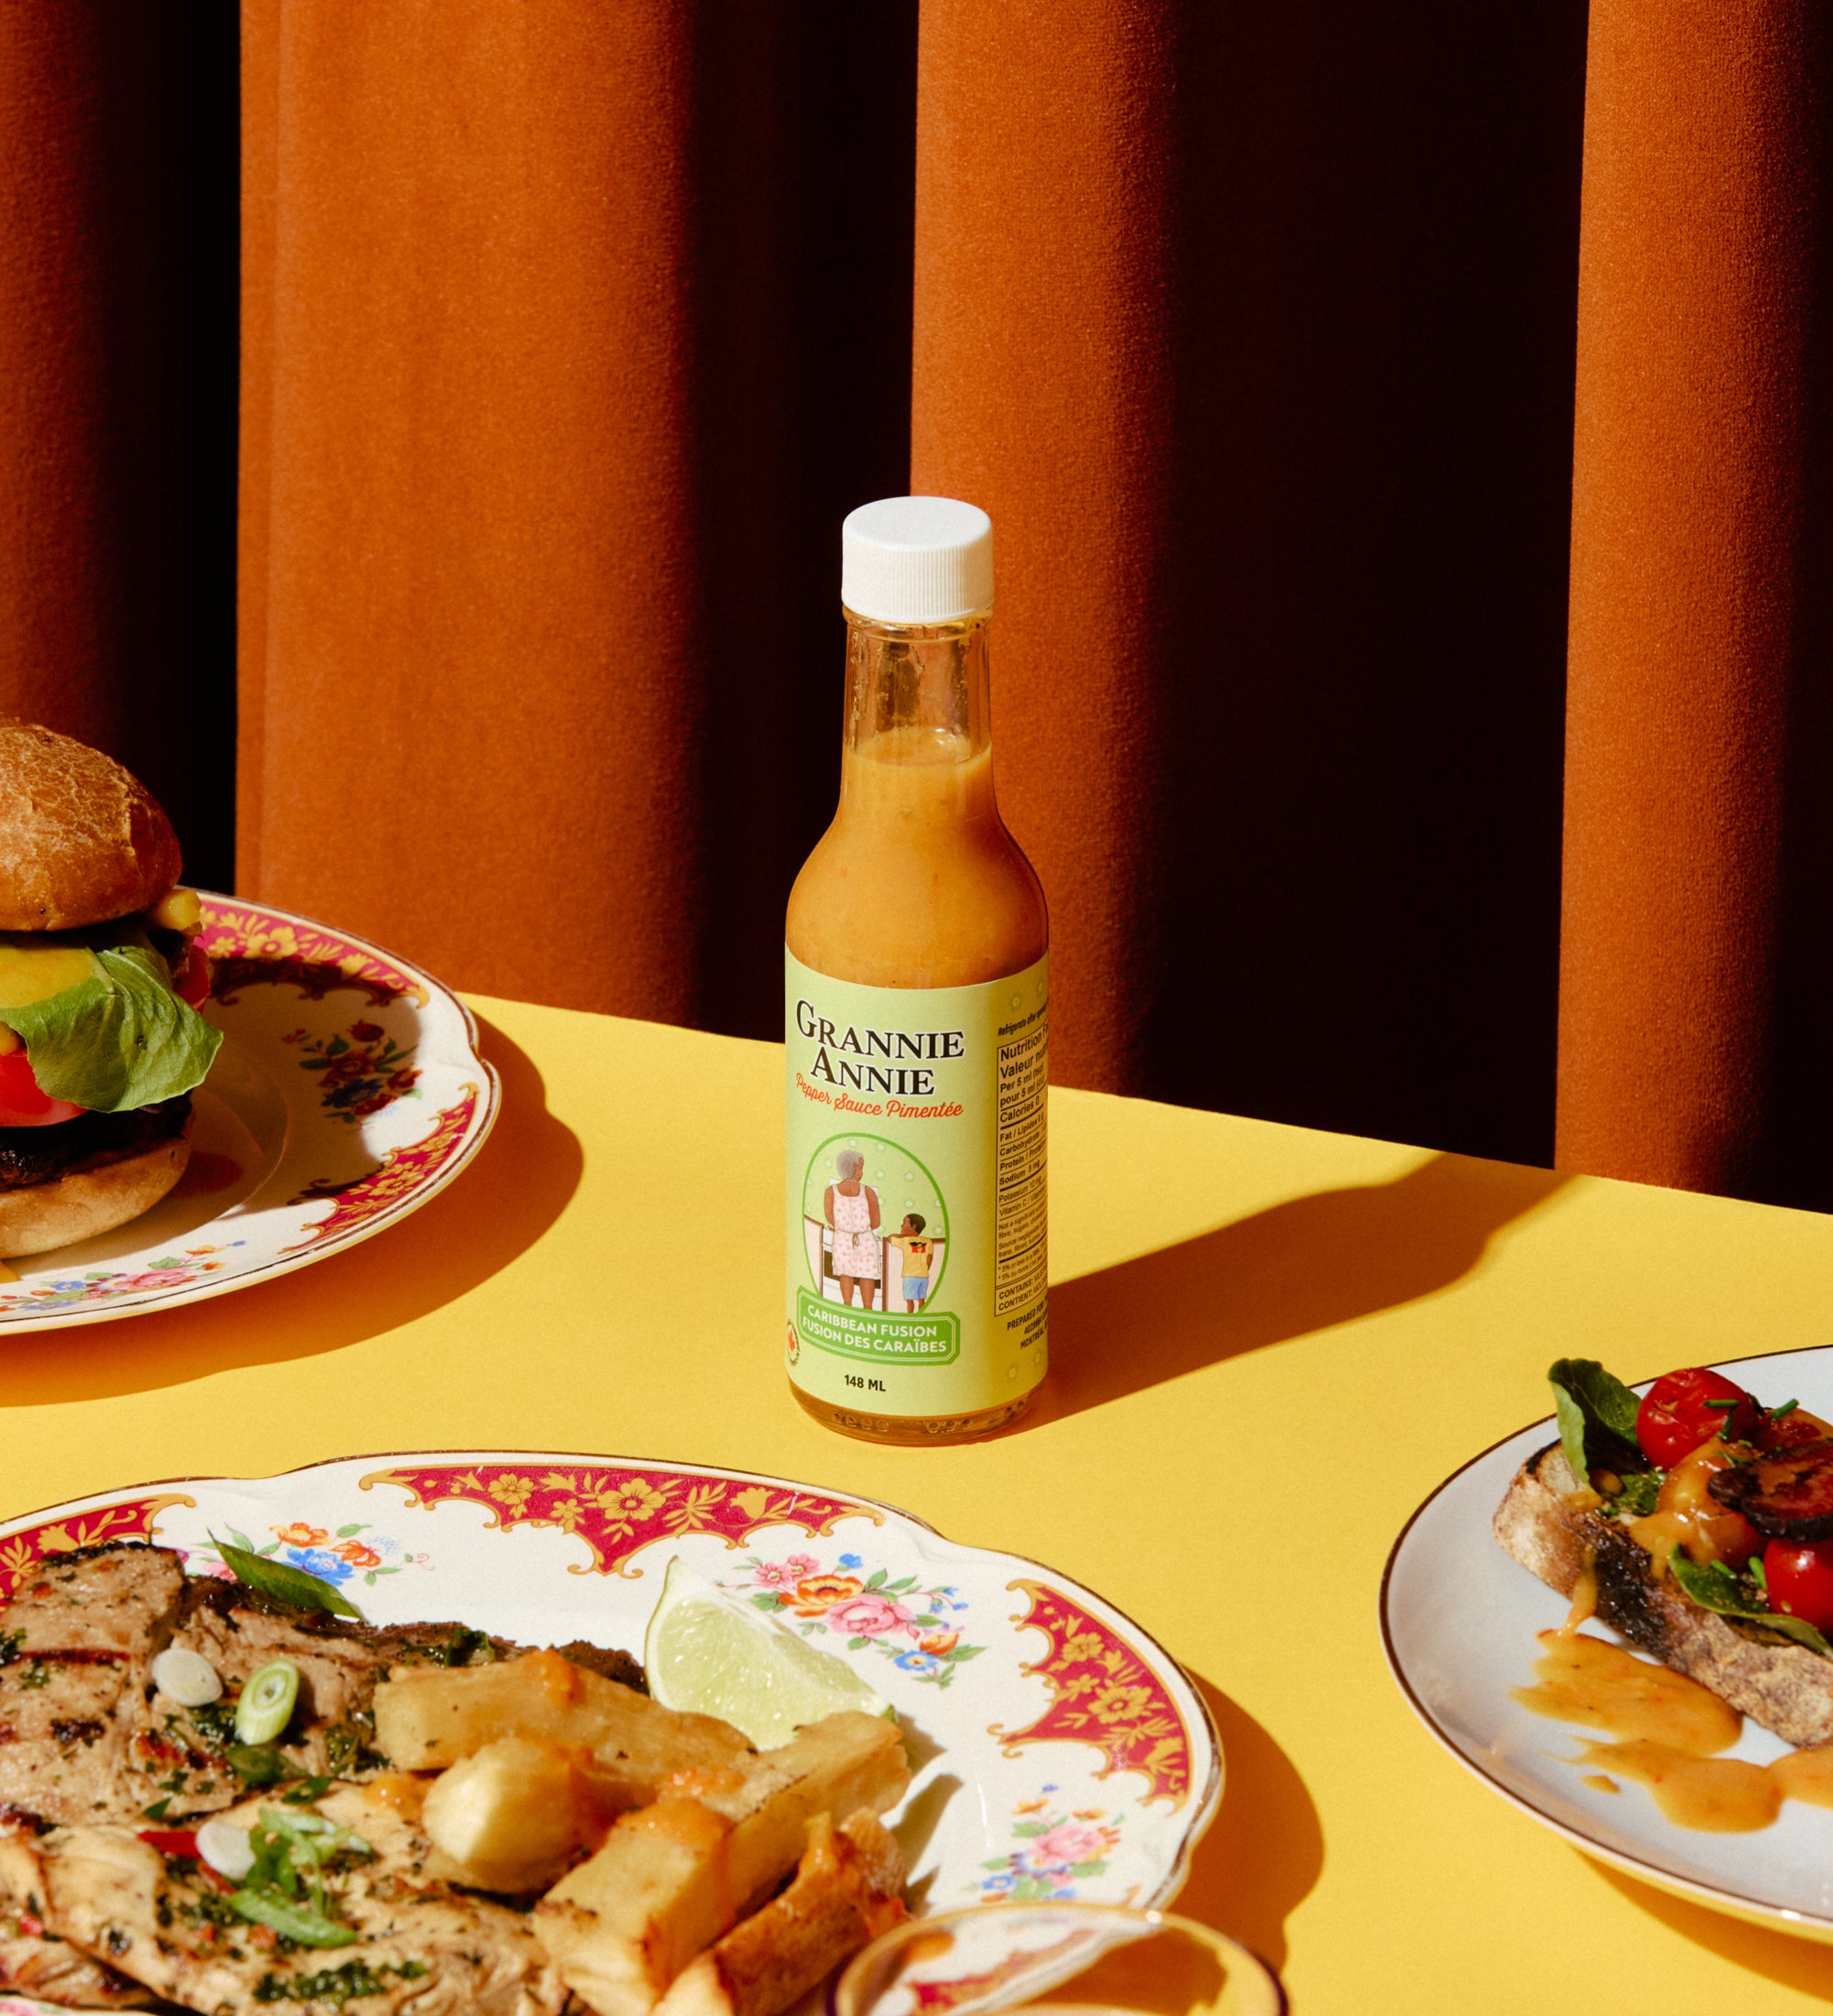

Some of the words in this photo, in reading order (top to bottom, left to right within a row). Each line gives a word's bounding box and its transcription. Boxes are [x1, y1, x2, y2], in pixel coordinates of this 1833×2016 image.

[796, 999, 965, 1060] GRANNIE
[1000, 1032, 1042, 1062] Nutrition
[811, 1046, 935, 1096] ANNIE
[999, 1056, 1034, 1079] Valeur
[999, 1081, 1015, 1093] Per
[1017, 1076, 1022, 1086] 5
[1023, 1071, 1032, 1084] ml
[796, 1073, 832, 1106] Pepper
[834, 1091, 883, 1117] Sauce
[886, 1099, 965, 1118] Pimentée
[999, 1092, 1020, 1108] pour
[1021, 1087, 1026, 1097] 5
[999, 1101, 1034, 1123] Calories
[1035, 1095, 1040, 1106] 0
[999, 1131, 1012, 1142] Fat
[999, 1155, 1025, 1171] Protein
[998, 1170, 1026, 1186] Sodium
[998, 1185, 1029, 1204] Potassium
[998, 1202, 1021, 1217] Vitamin
[998, 1278, 1034, 1300] CONTAINS:
[807, 1304, 878, 1335] CARIBBEAN
[880, 1324, 937, 1338] FUSION
[1007, 1308, 1036, 1332] PREPARED
[802, 1316, 843, 1344] FUSION
[844, 1333, 870, 1349] DES
[873, 1339, 947, 1353] CARAÏBES
[844, 1374, 865, 1389] 148
[868, 1379, 887, 1392] ML
